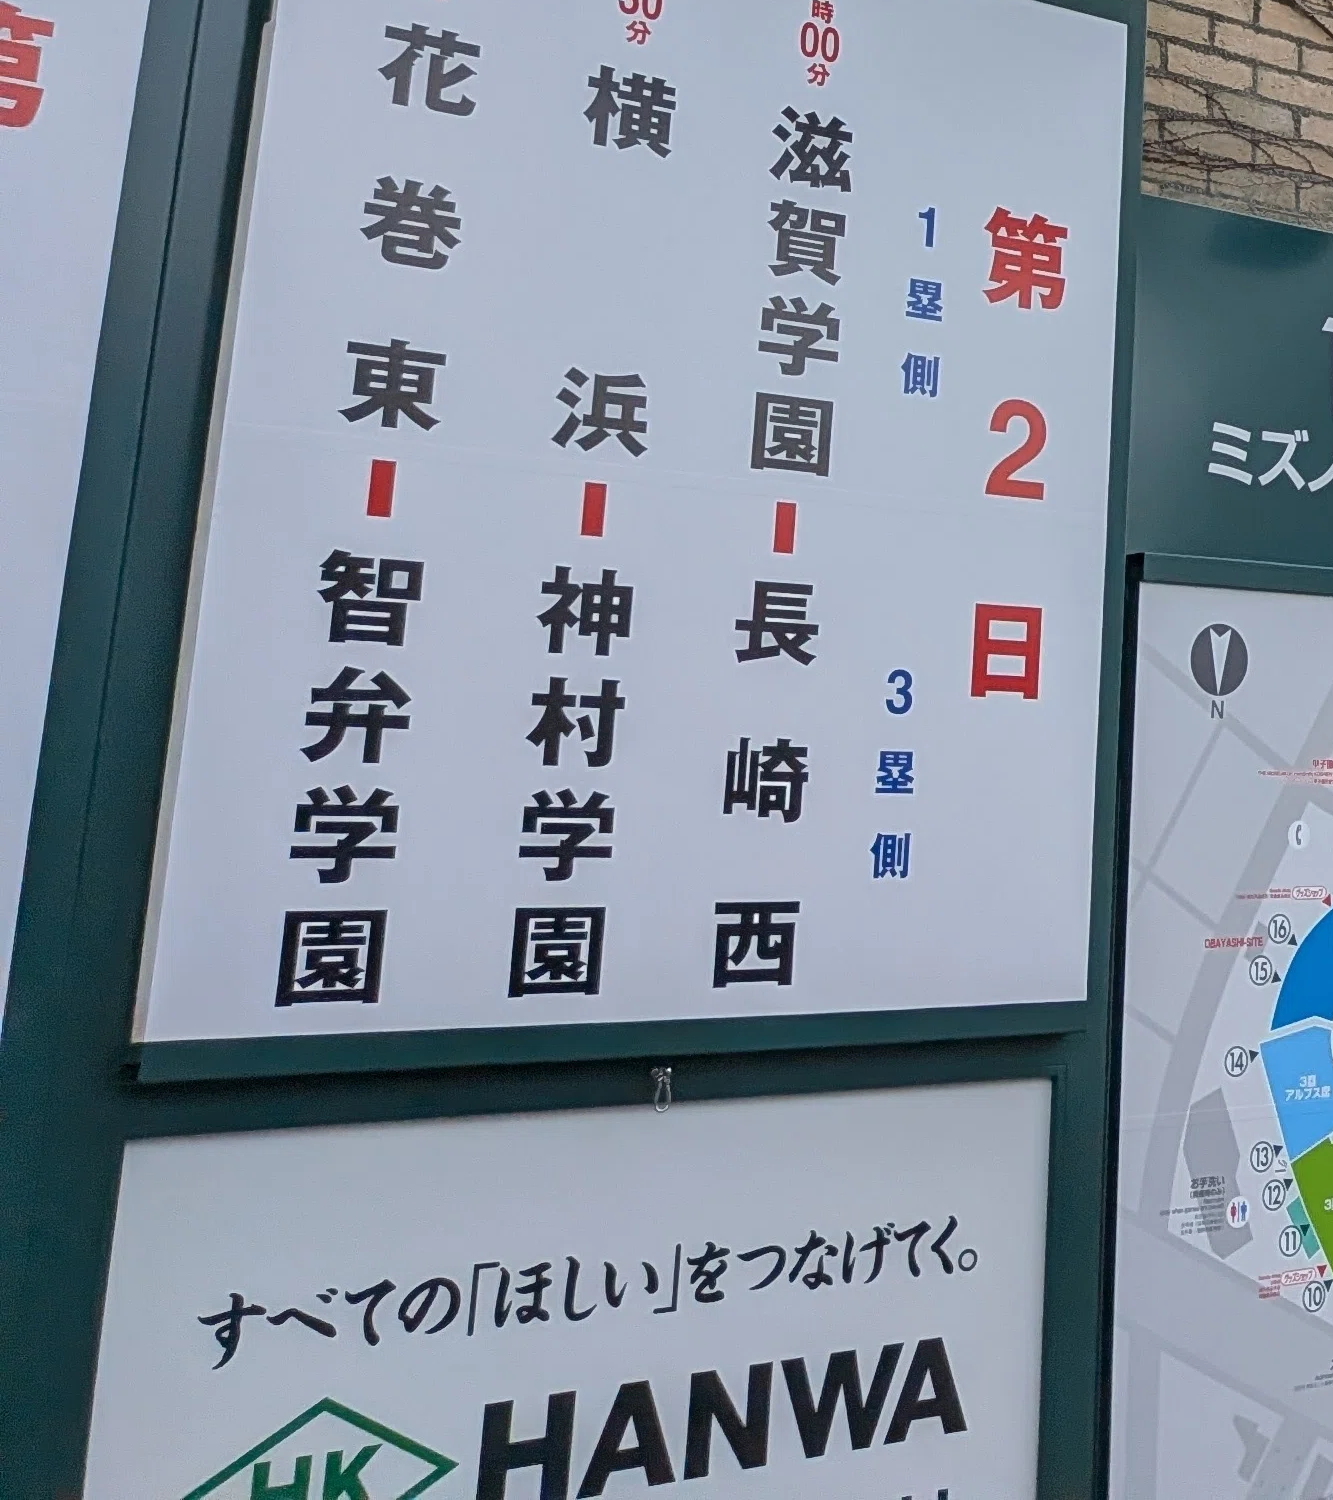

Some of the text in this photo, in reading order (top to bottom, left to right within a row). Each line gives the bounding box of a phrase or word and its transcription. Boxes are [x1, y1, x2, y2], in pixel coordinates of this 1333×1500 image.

[750, 106, 855, 478] 滋賀学園
[900, 205, 945, 399] 1塁側
[273, 547, 426, 1008] 智弁学園
[508, 565, 636, 999] 神村学園
[869, 667, 916, 881] 3塁側
[1210, 700, 1225, 719] N
[199, 1215, 980, 1370] すべての「ほしい」をつなげてく。
[250, 1443, 384, 1500] HK
[476, 1336, 969, 1500] HANWA
